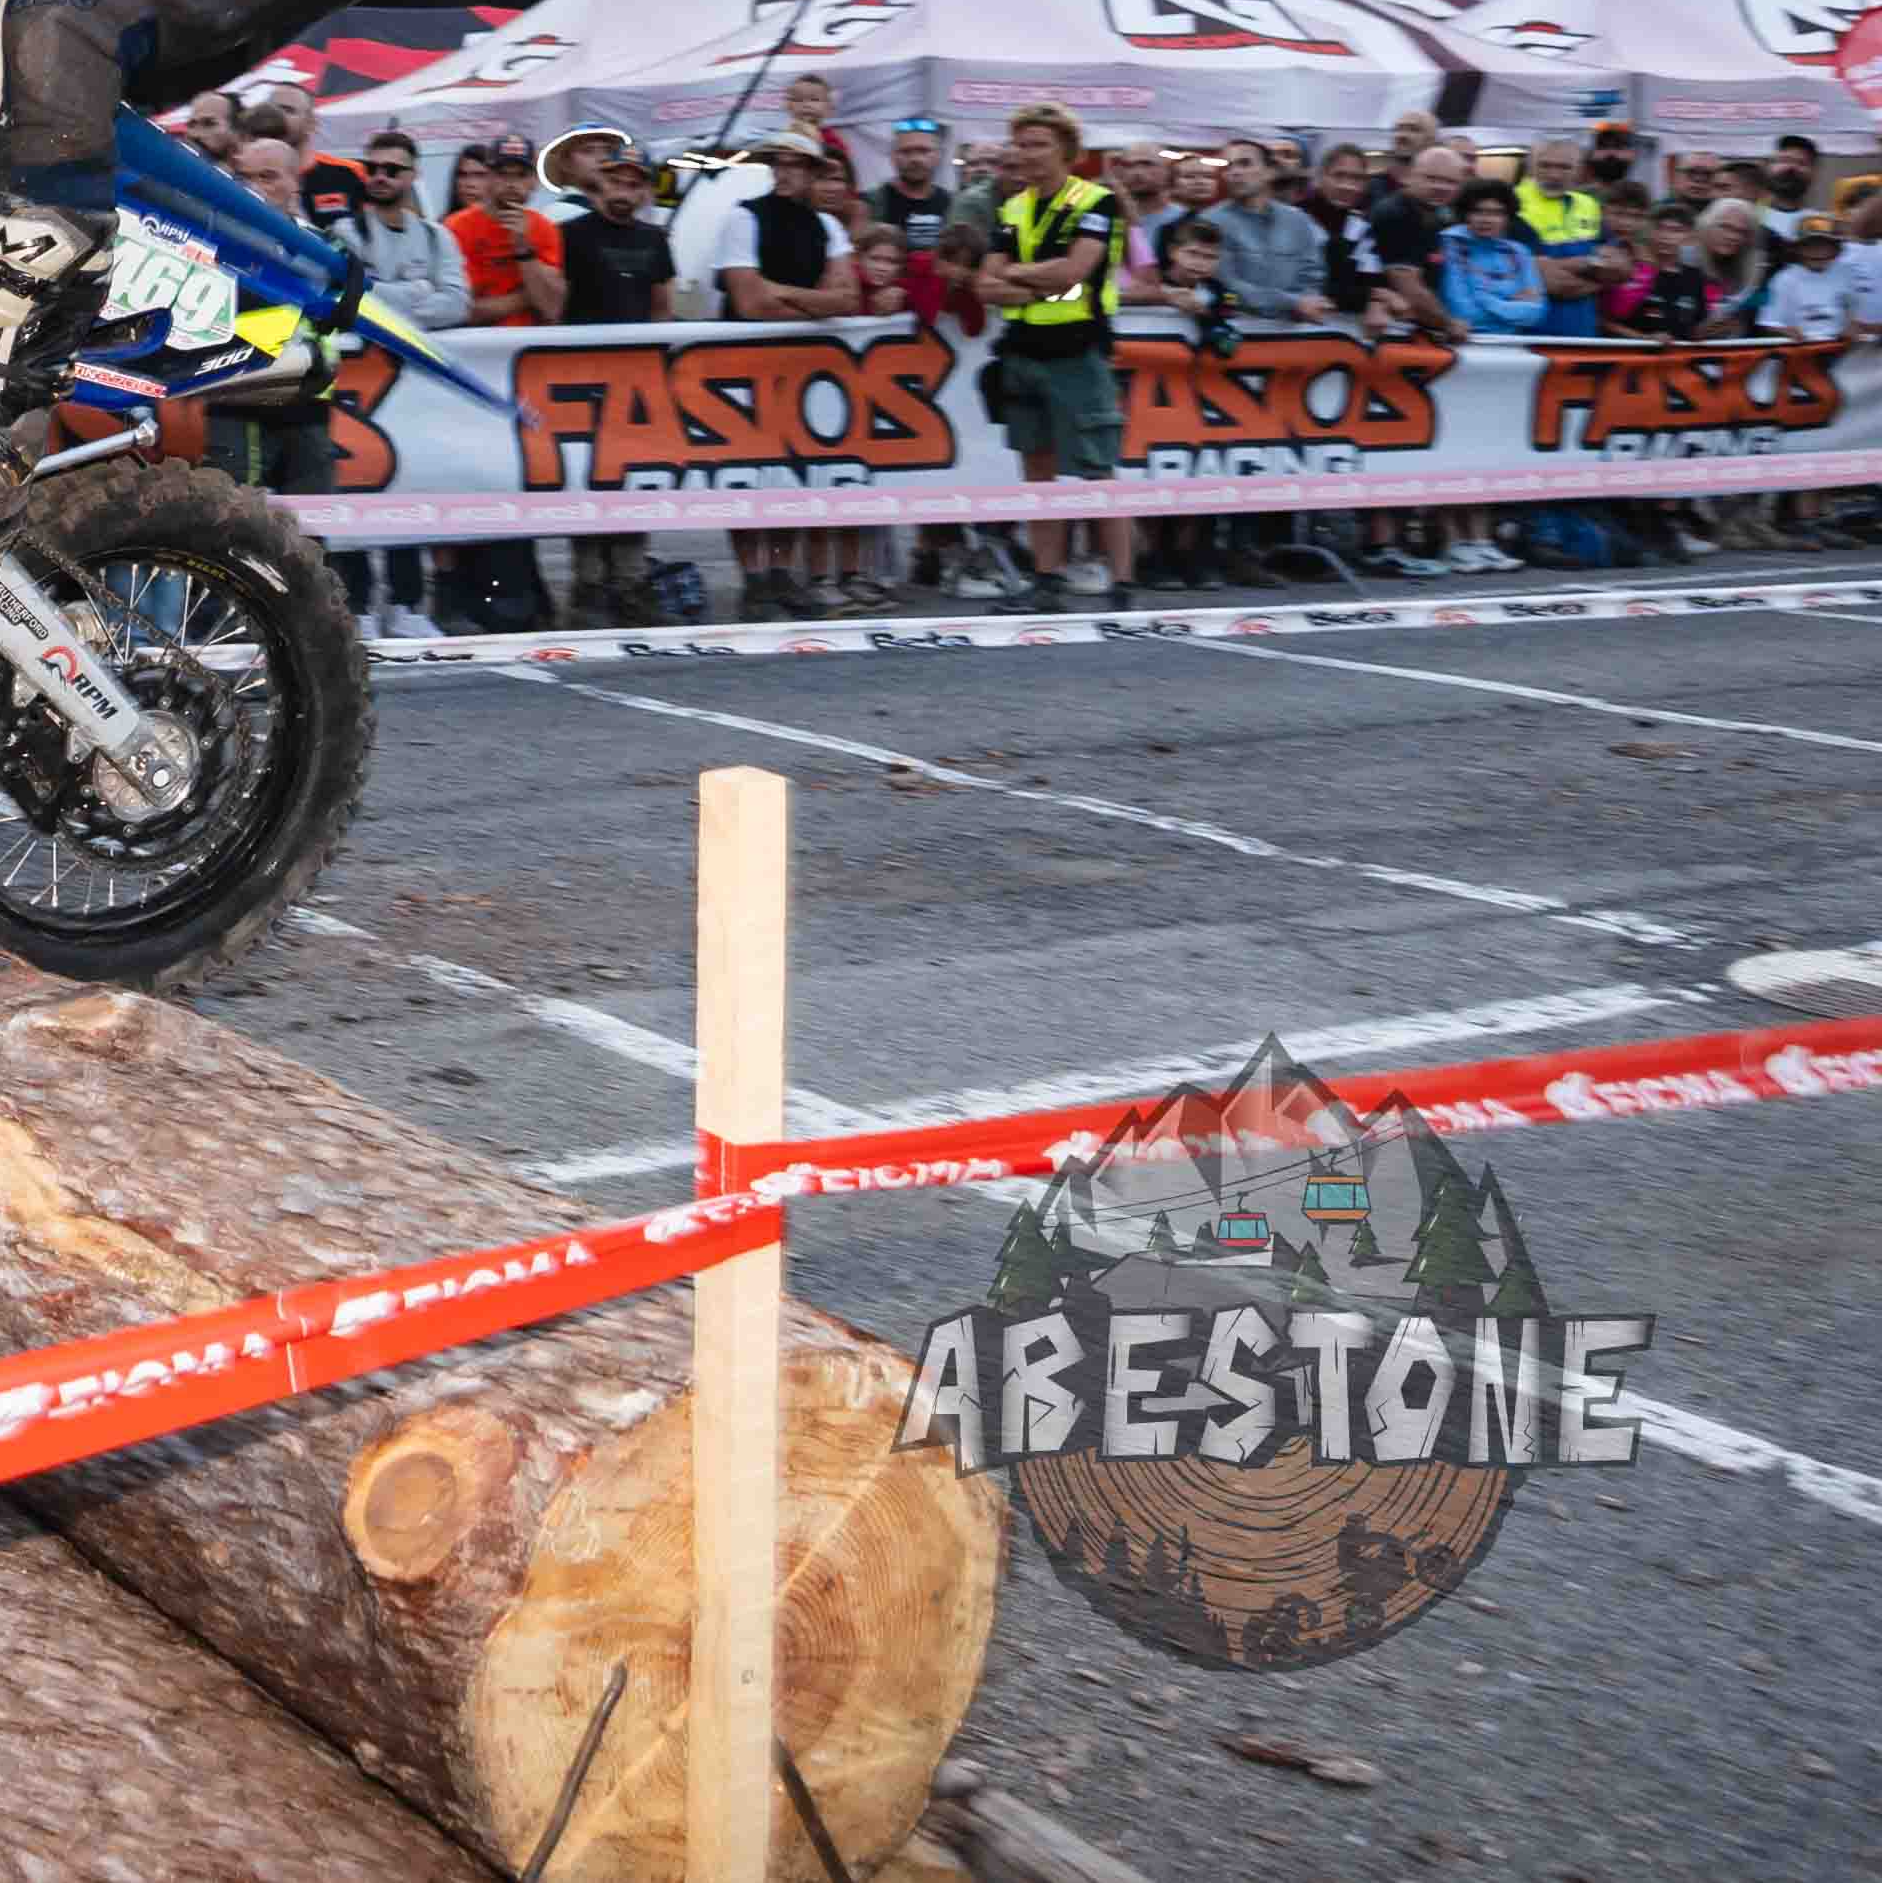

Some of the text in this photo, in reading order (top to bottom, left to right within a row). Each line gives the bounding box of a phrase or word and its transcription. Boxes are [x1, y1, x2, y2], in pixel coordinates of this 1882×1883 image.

[194, 346, 254, 377] 300
[74, 673, 118, 720] RPM
[1597, 1068, 1762, 1118] EICMA
